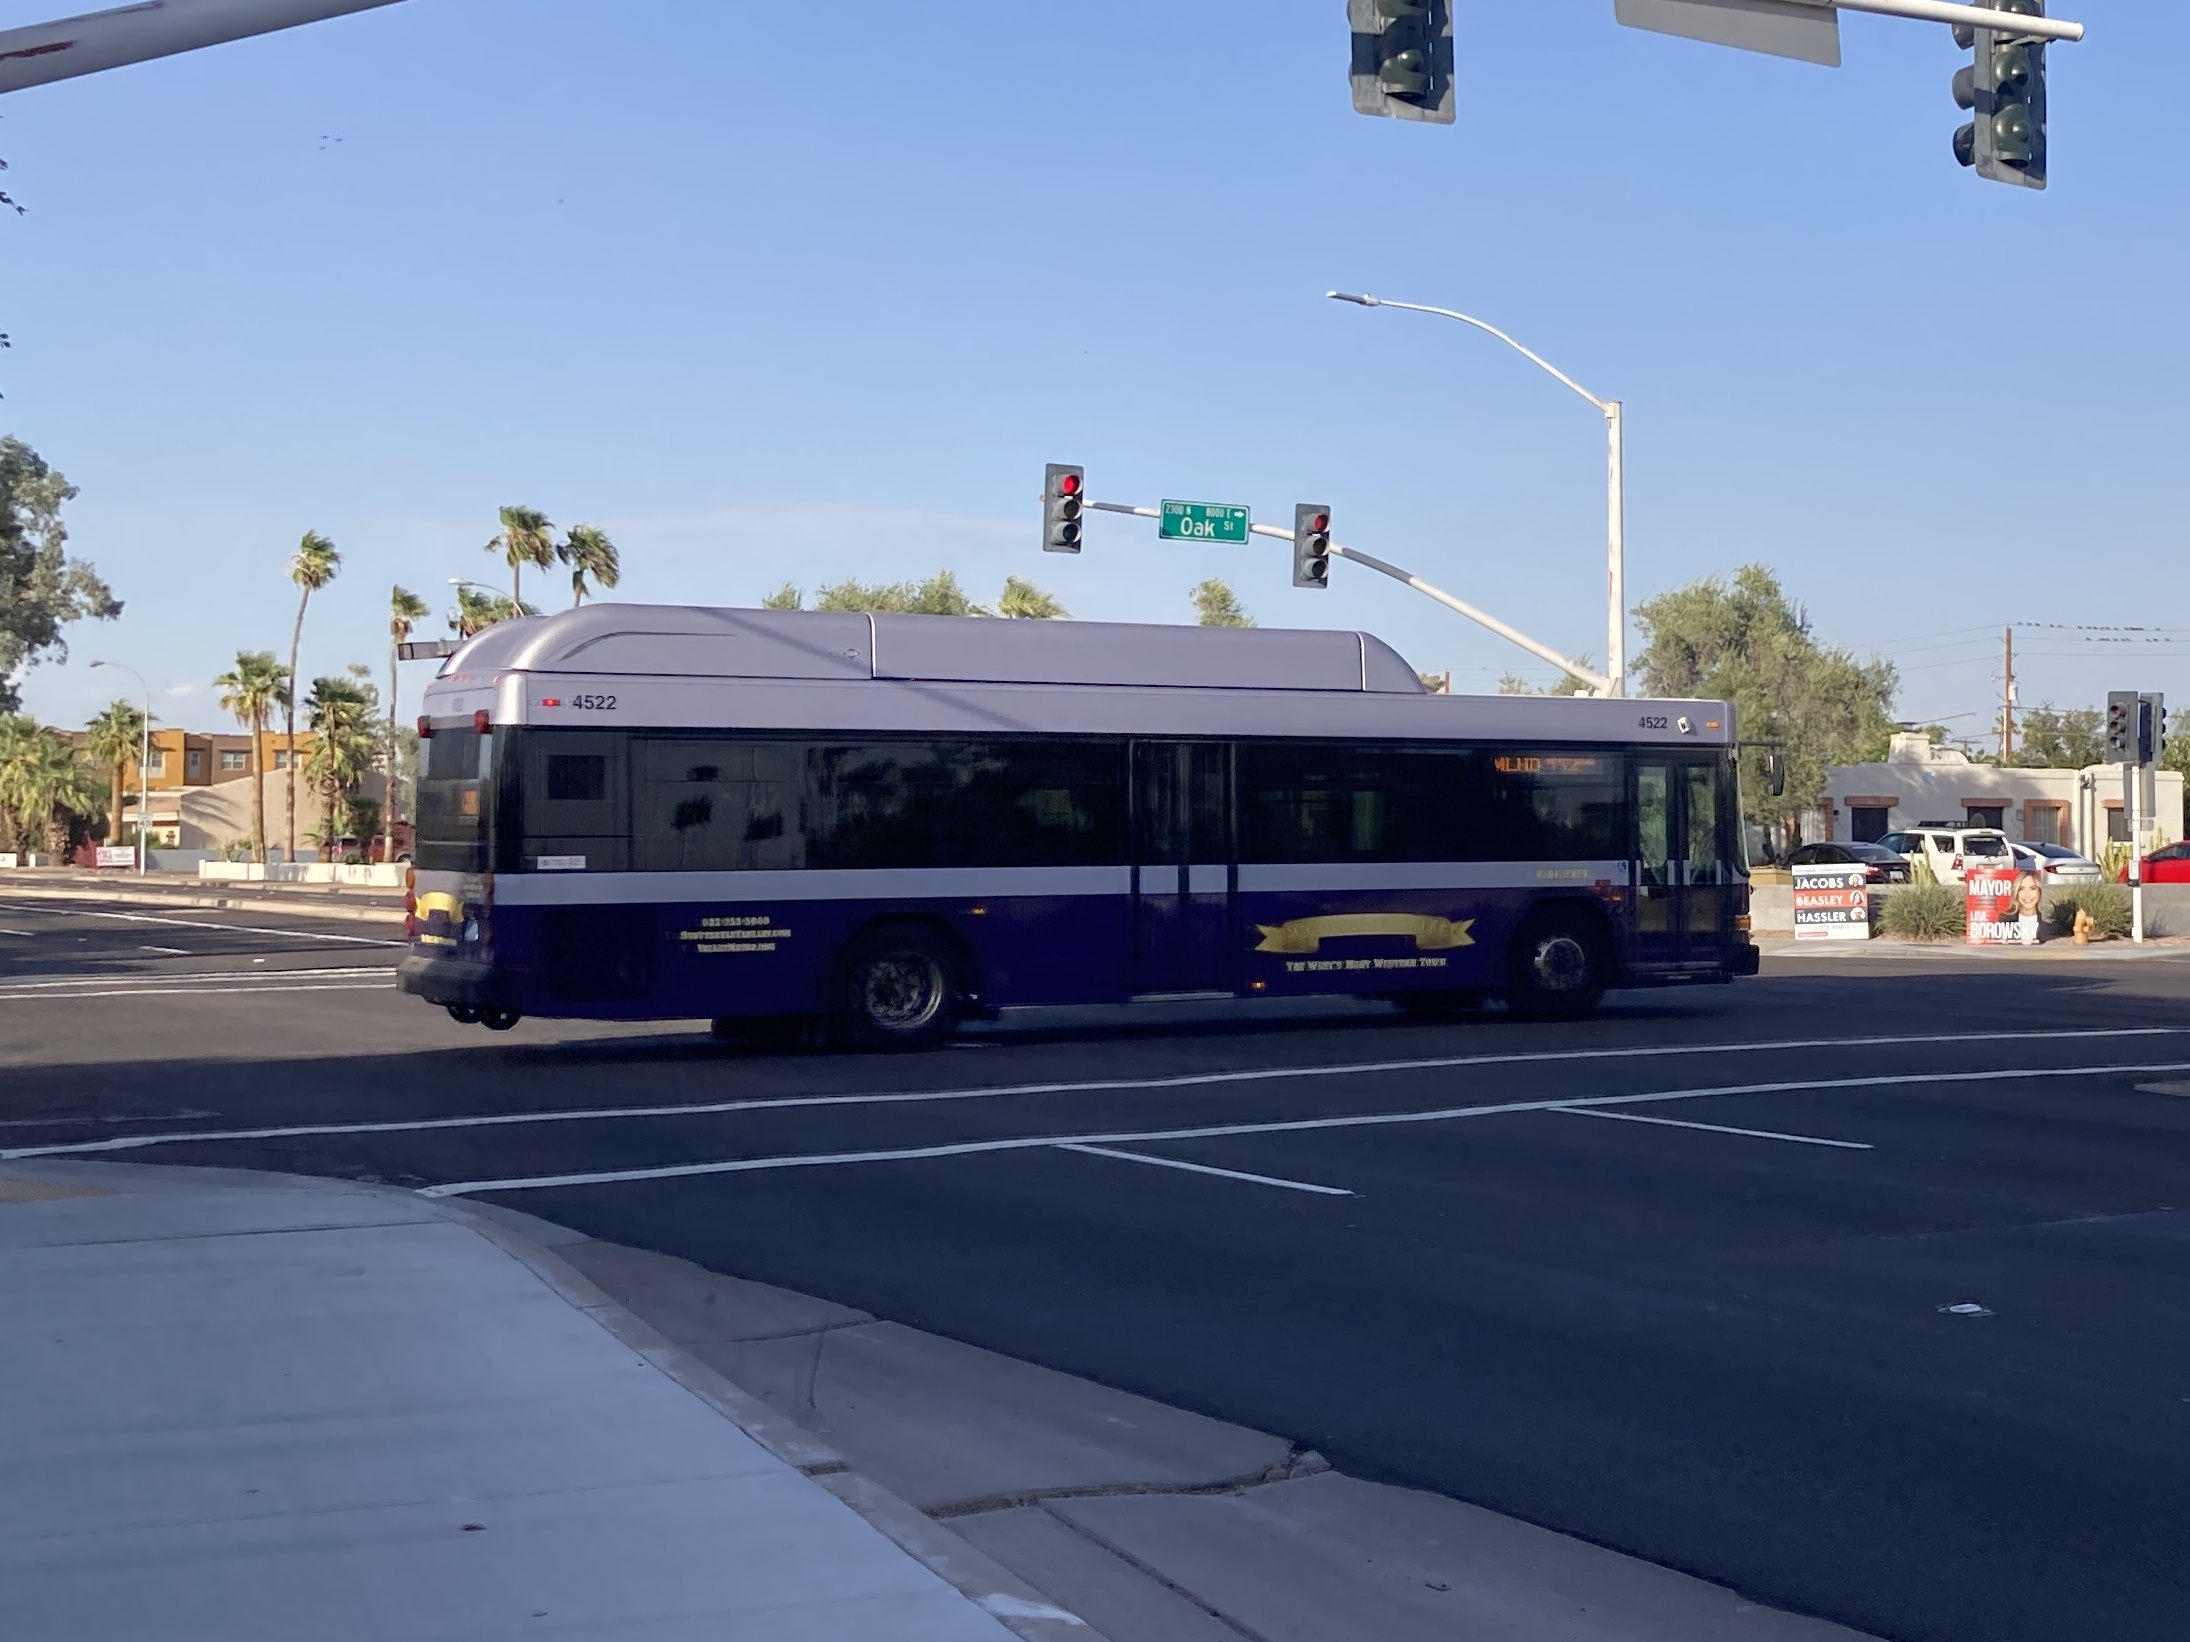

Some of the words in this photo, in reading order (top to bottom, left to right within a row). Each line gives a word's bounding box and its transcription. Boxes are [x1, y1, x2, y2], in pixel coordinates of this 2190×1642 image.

[1180, 516, 1216, 538] Oak
[1223, 520, 1234, 531] St
[572, 694, 617, 710] 4522
[1638, 716, 1668, 729] 4522
[1794, 877, 1844, 890] JACOBS
[1968, 879, 2012, 897] MAYOR
[1795, 894, 1844, 907] BEASLEY
[1796, 911, 1847, 924] HASSLER
[1970, 910, 1987, 922] LISA
[1970, 921, 2039, 939] BOROWSKY
